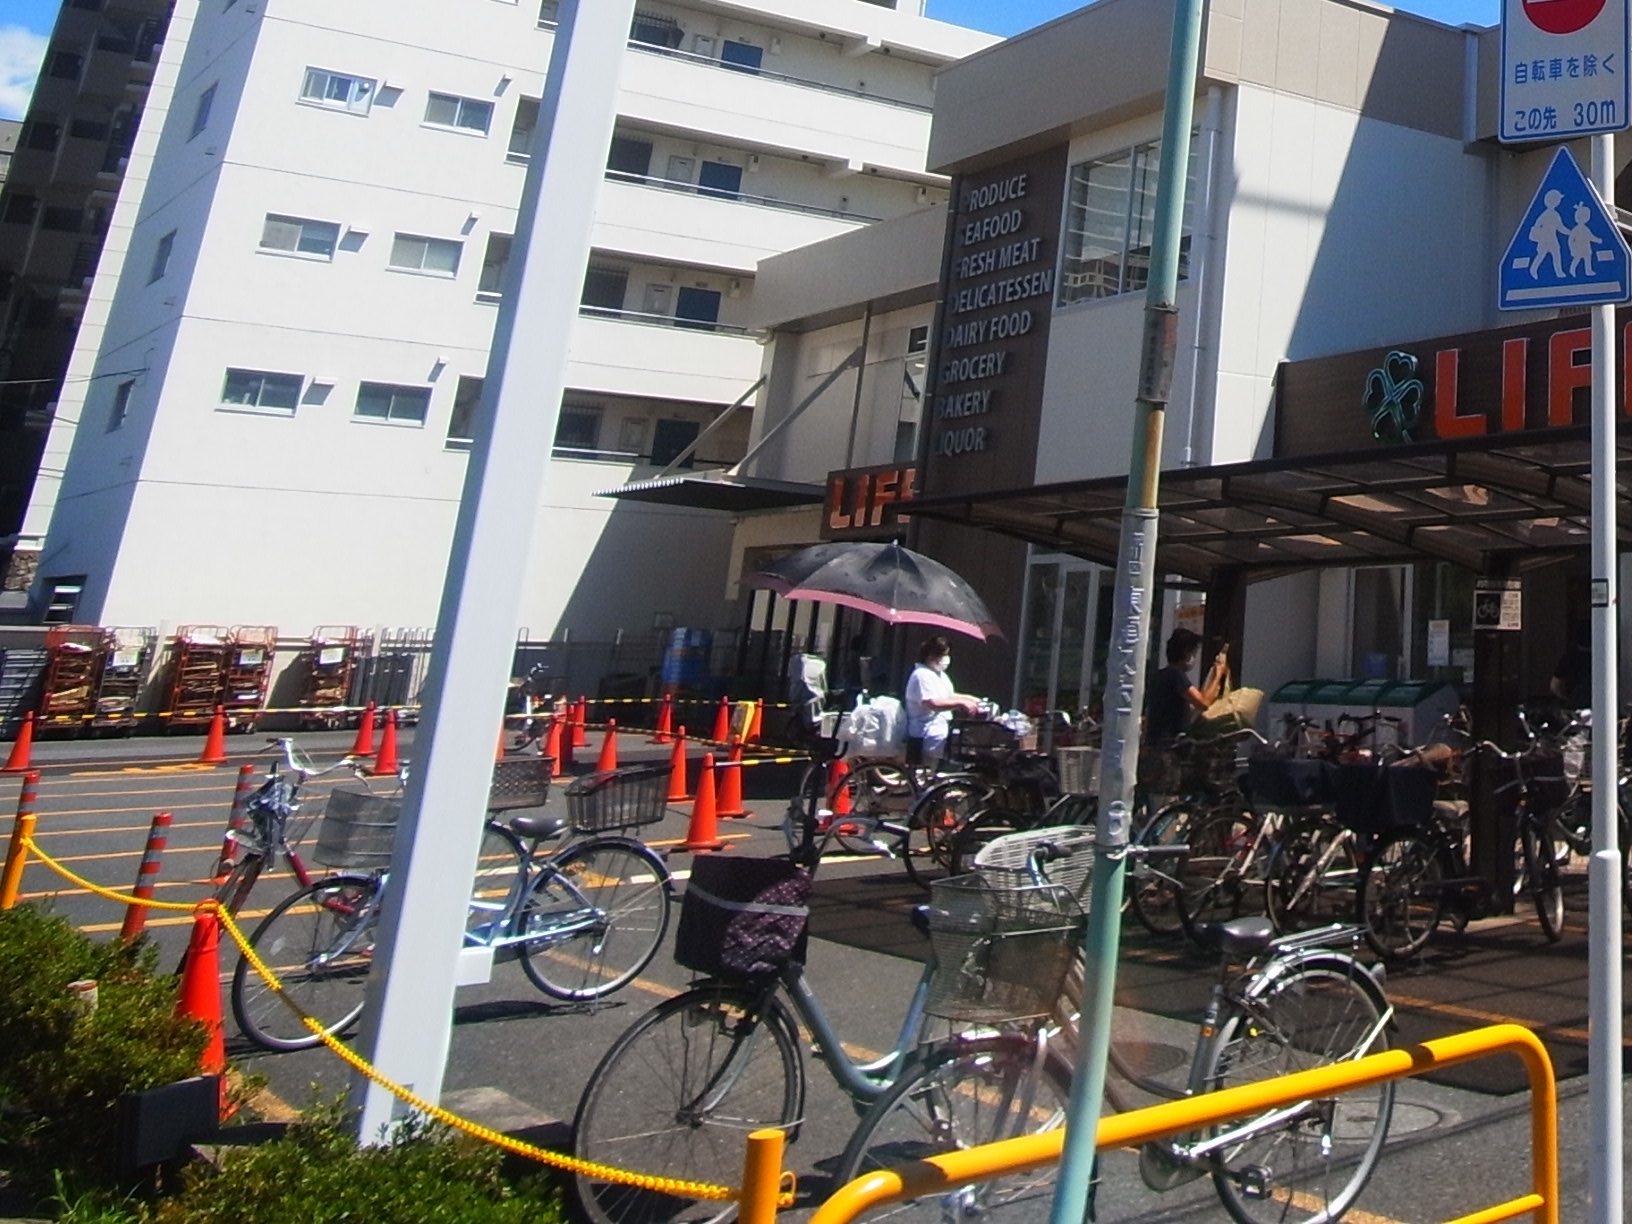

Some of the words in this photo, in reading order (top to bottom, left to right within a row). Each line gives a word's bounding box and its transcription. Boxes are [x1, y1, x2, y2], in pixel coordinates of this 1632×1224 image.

[1513, 53, 1616, 85] 自転車を除く
[1513, 105, 1557, 132] この先
[1573, 98, 1617, 127] 30m
[960, 173, 1027, 212] PRODUCE
[952, 247, 997, 280] FRESH
[998, 237, 1041, 269] MEAT
[950, 270, 1052, 313] DELICATESSEN
[944, 319, 988, 349] DAIRY
[989, 310, 1032, 341] FOOD
[942, 352, 1005, 384] GROCERY
[936, 389, 991, 419] BAKERY
[934, 426, 986, 457] LIQUOR
